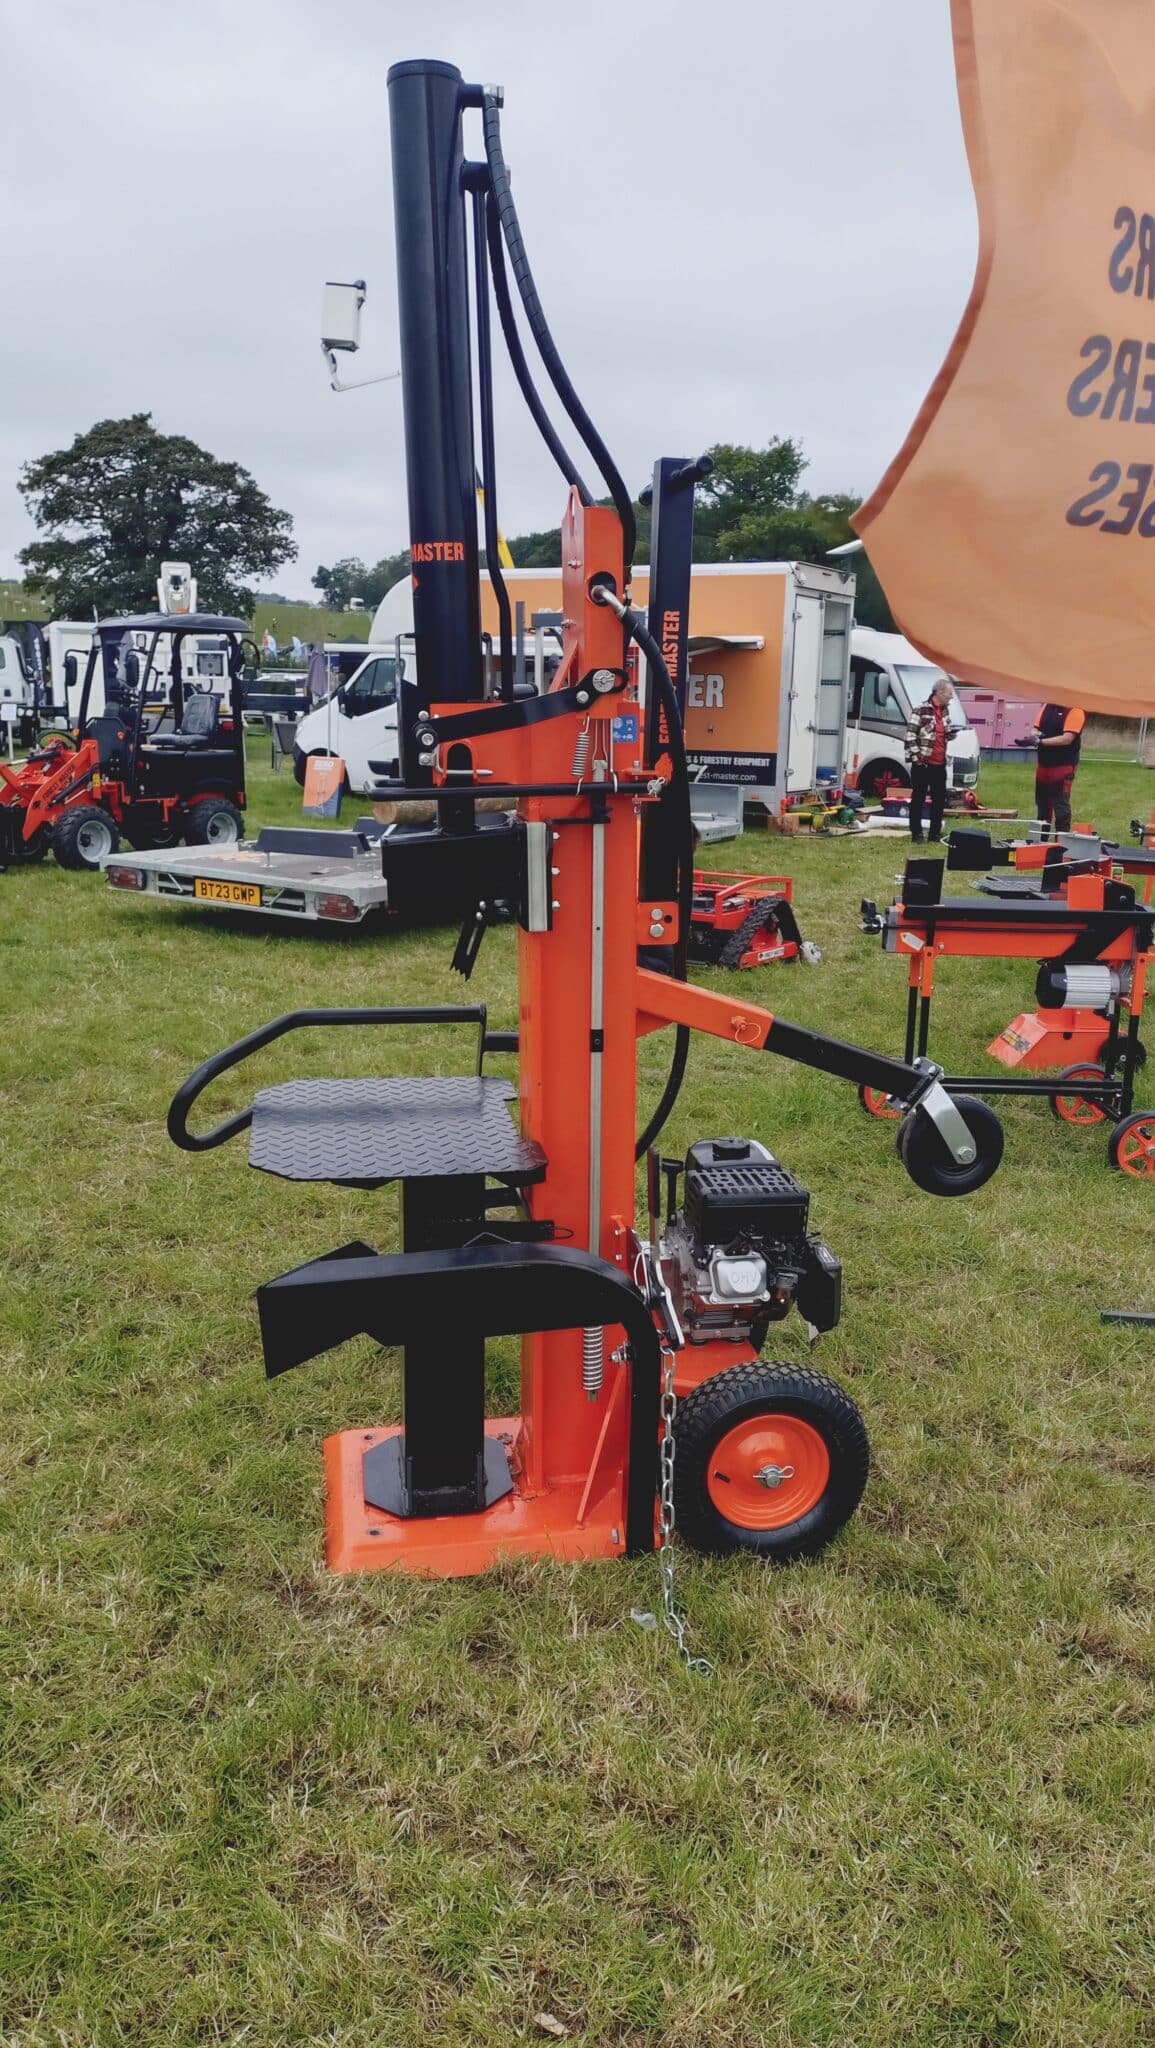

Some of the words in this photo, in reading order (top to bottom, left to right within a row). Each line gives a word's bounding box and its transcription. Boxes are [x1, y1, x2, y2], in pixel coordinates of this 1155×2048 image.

[700, 756, 732, 765] FORESTRY
[733, 758, 770, 766] EQUIPMENT
[200, 882, 230, 899] BT23
